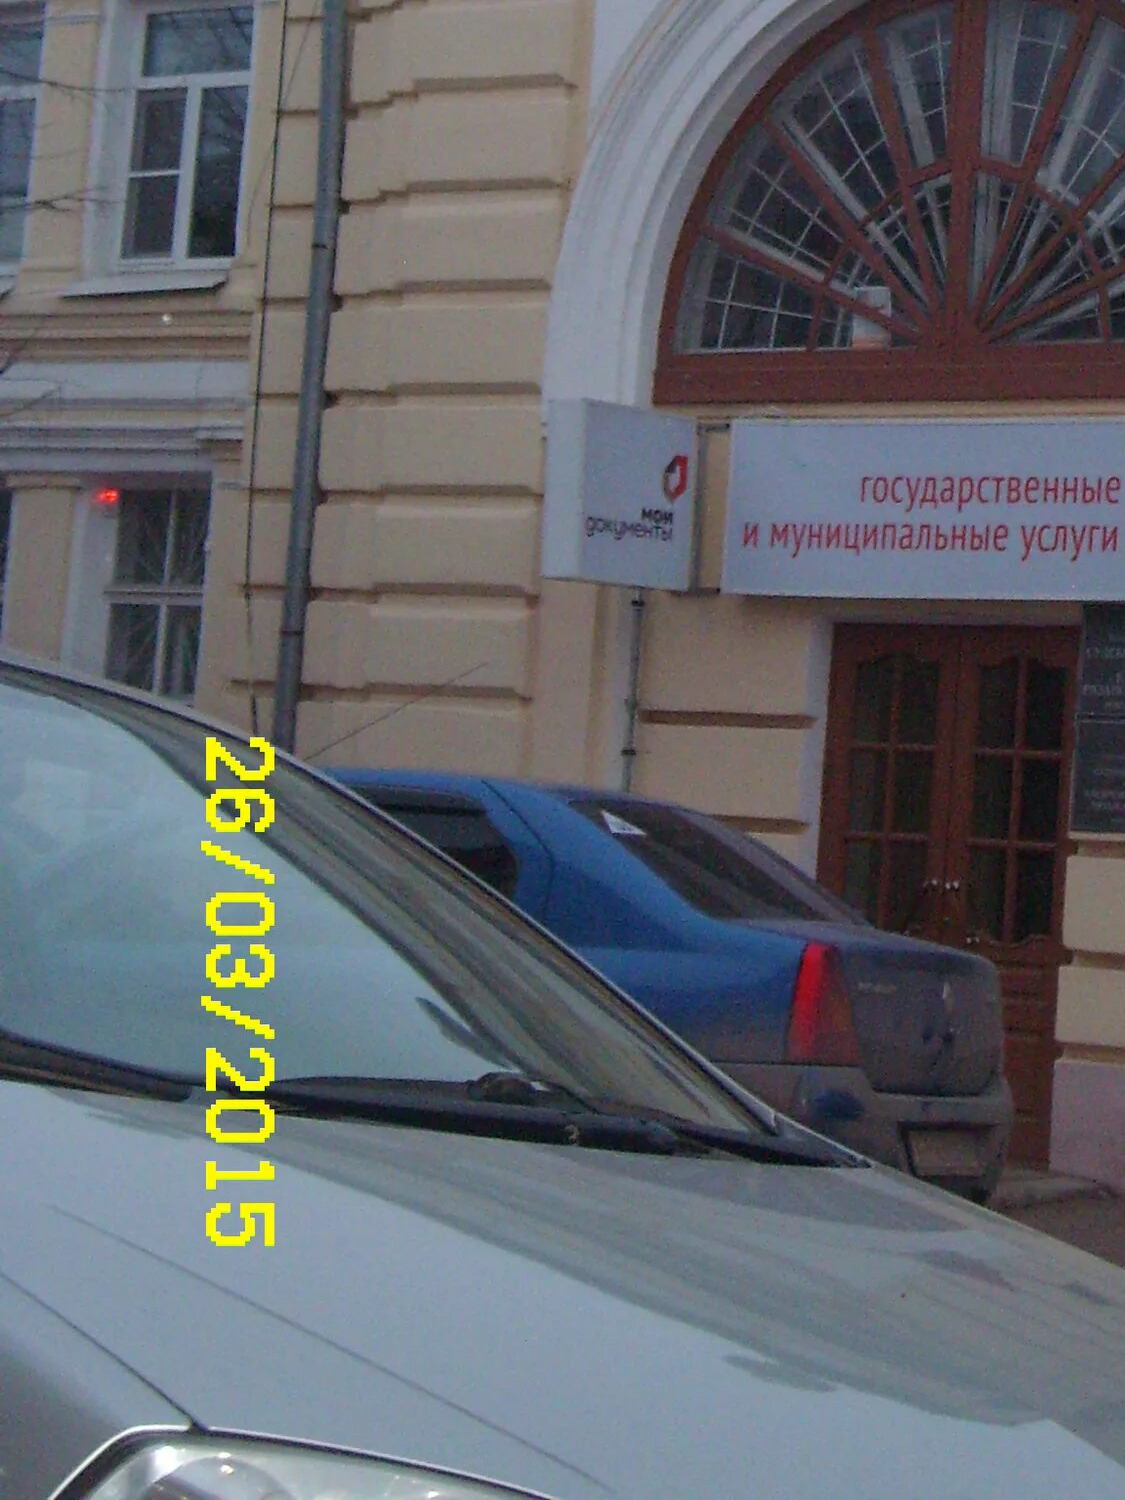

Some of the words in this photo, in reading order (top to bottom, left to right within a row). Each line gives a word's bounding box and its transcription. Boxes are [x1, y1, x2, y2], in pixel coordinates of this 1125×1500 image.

[861, 475, 1121, 512] государственные
[584, 516, 673, 542] документы
[742, 522, 760, 548] и
[770, 522, 1008, 558] муниципальные
[1020, 524, 1119, 562] услуги
